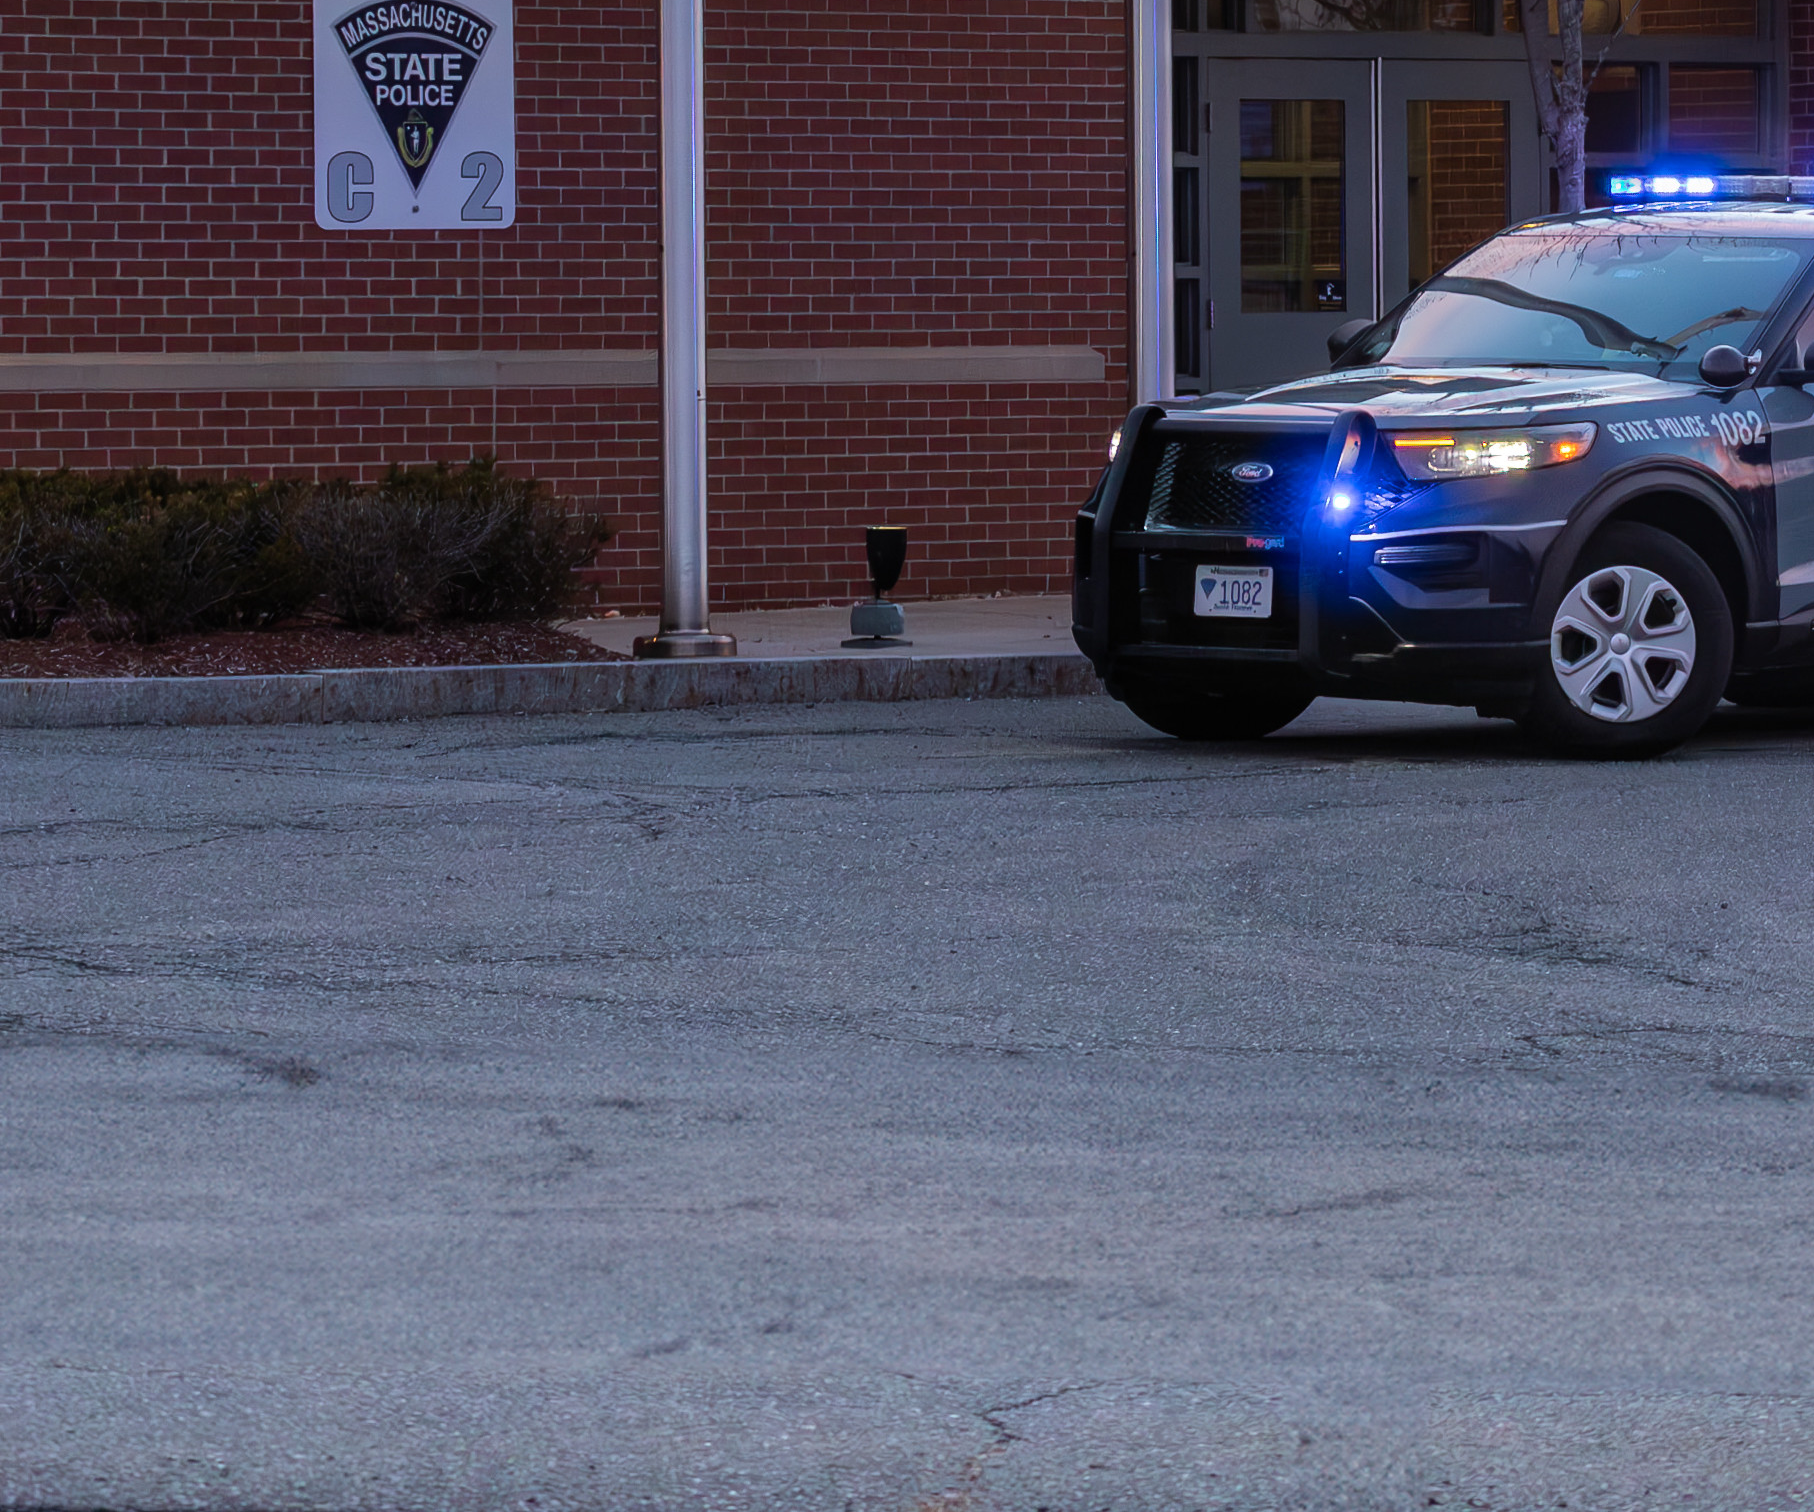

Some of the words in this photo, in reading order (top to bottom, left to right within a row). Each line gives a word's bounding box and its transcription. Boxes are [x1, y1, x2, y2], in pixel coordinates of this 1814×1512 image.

[341, 3, 488, 50] MASSACHUSETTS
[365, 53, 462, 81] STATE
[376, 85, 454, 106] POLICE
[327, 151, 374, 223] C
[461, 151, 504, 221] 2
[1606, 419, 1660, 444] STATE
[1655, 415, 1710, 439] POLICE
[1711, 410, 1766, 447] 1082
[1220, 580, 1262, 606] 1082
